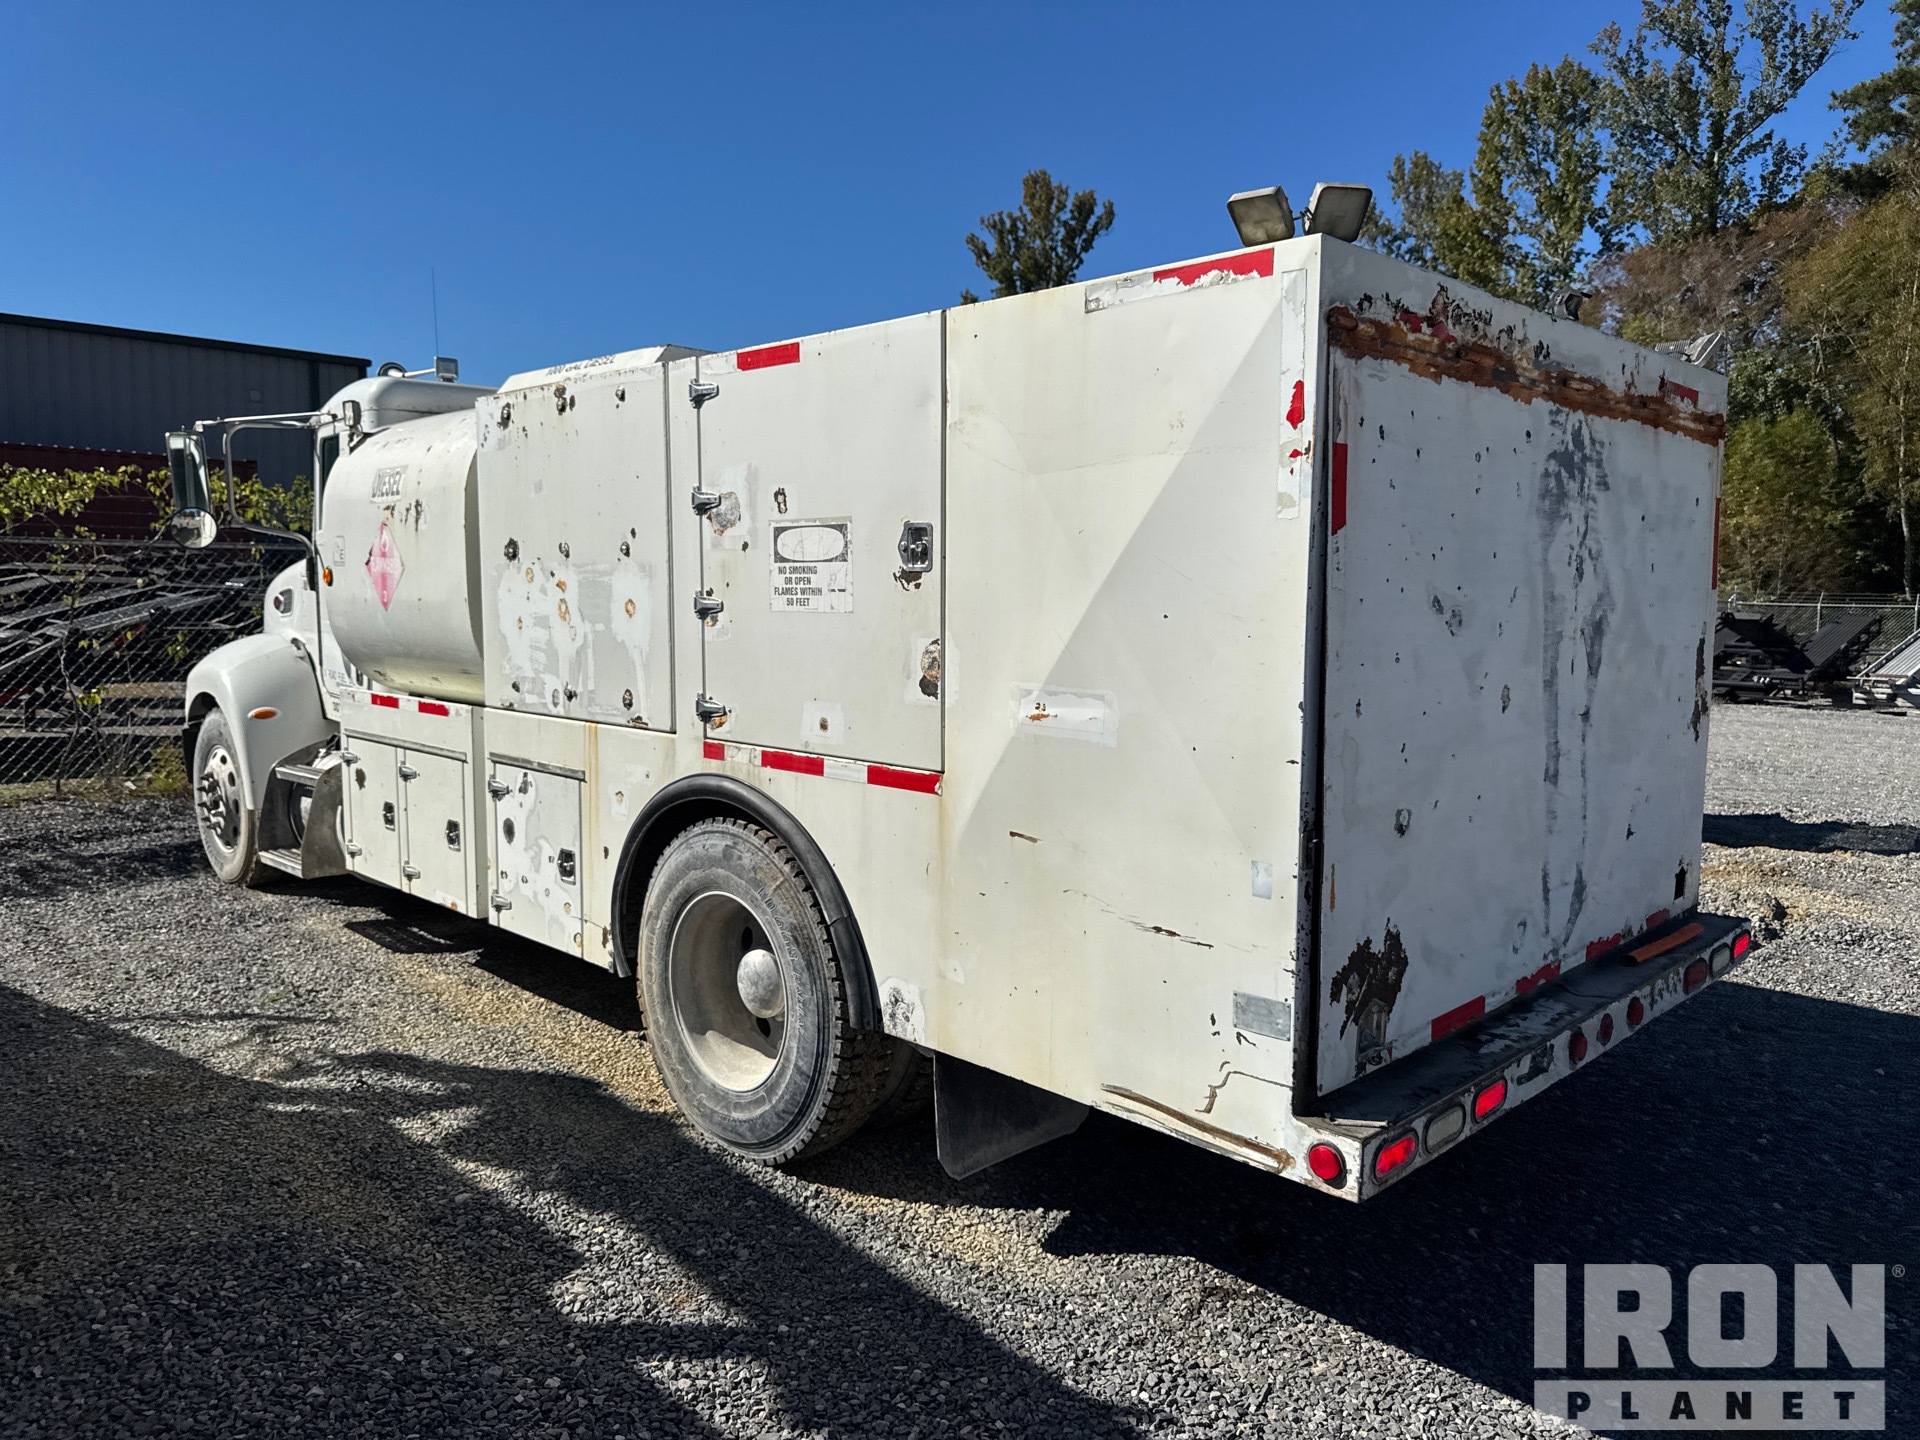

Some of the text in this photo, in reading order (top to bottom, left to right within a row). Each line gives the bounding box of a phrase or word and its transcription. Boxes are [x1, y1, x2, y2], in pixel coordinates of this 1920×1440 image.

[372, 471, 402, 498] DIESEL
[778, 566, 818, 575] NO SMOKING
[784, 577, 811, 585] OR OPEN
[774, 587, 822, 596] FLAMES WITHIN
[786, 598, 810, 606] 50 FEET
